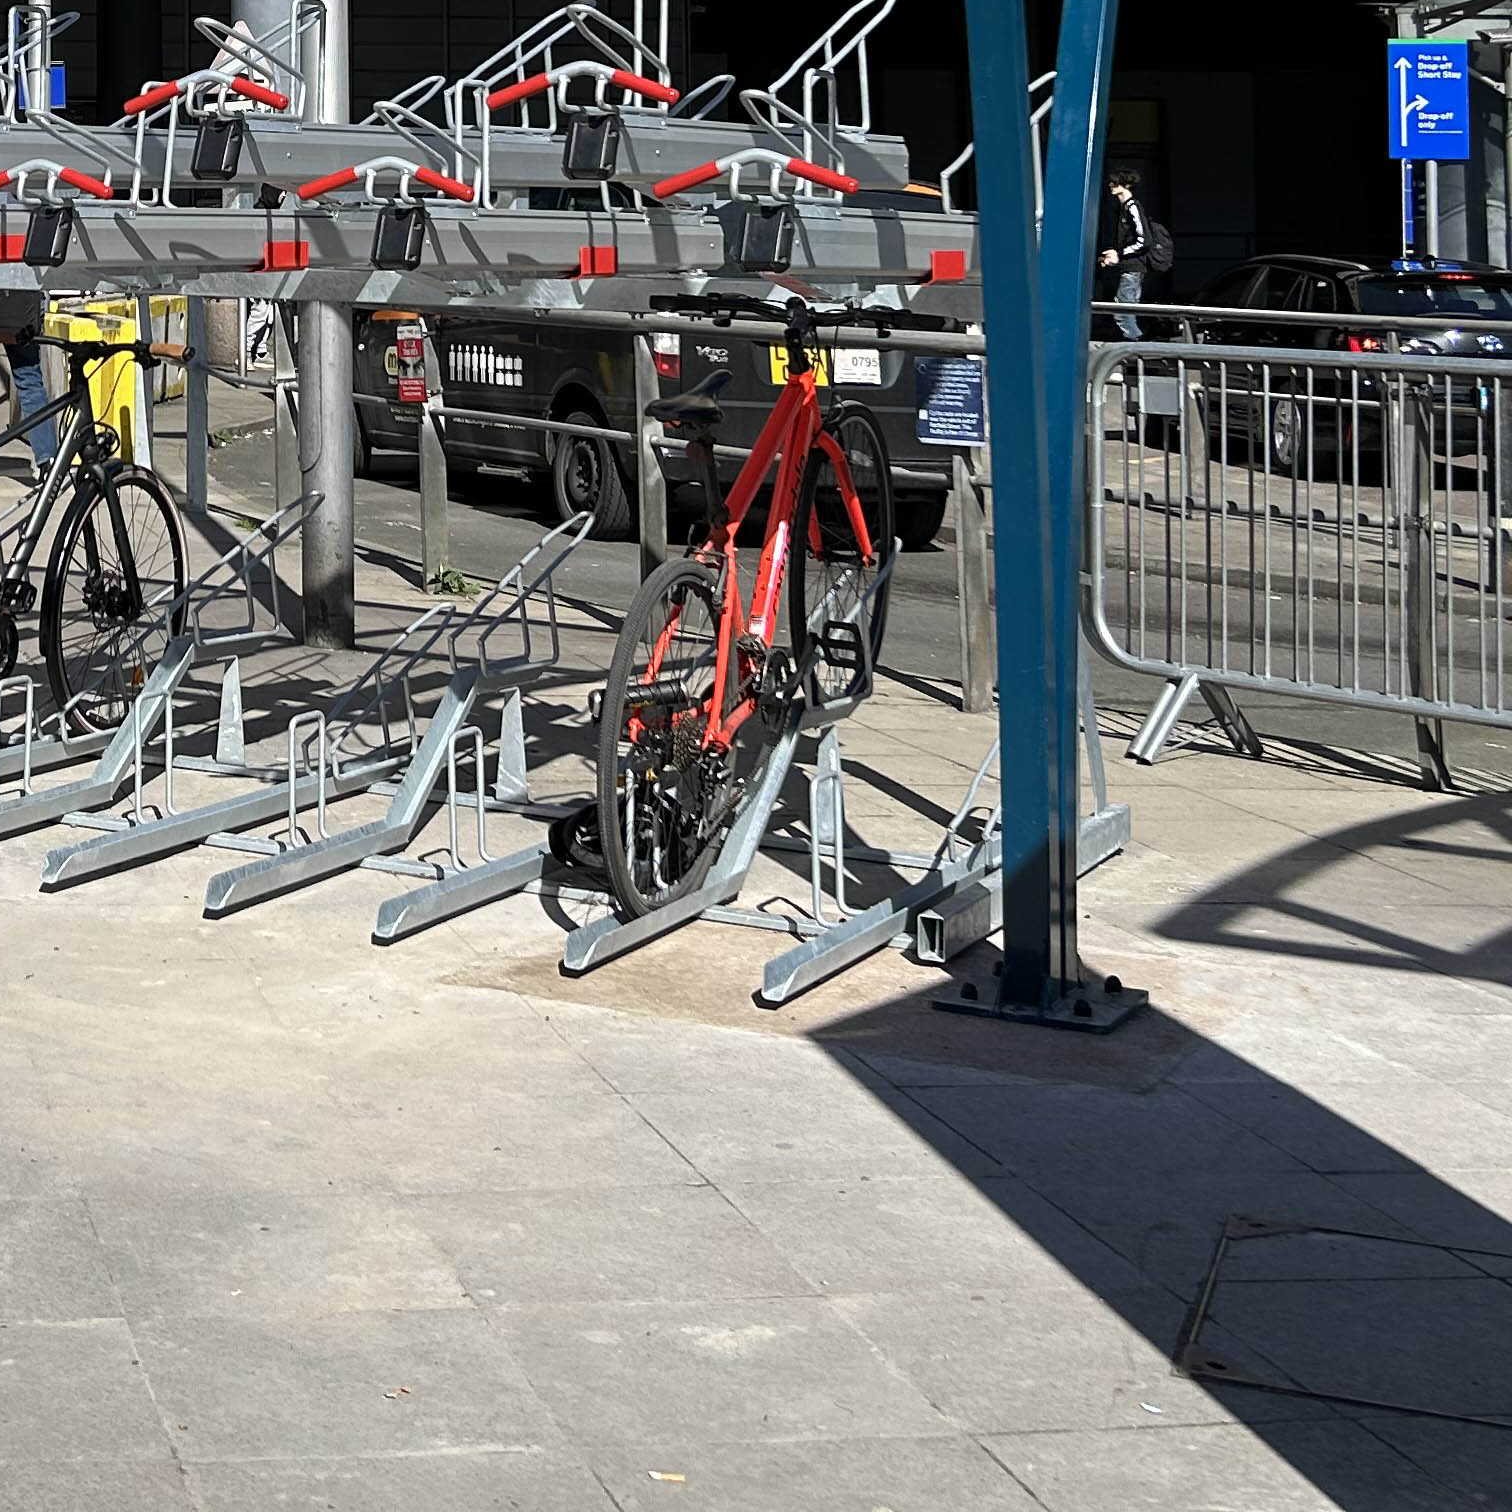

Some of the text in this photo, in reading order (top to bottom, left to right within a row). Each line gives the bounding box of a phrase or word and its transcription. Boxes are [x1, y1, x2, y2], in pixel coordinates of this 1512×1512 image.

[1418, 62, 1453, 70] Drop-off
[1418, 71, 1462, 80] Short Stay
[1418, 112, 1454, 120] Drop-off
[1418, 121, 1436, 129] only
[851, 356, 878, 367] 0795
